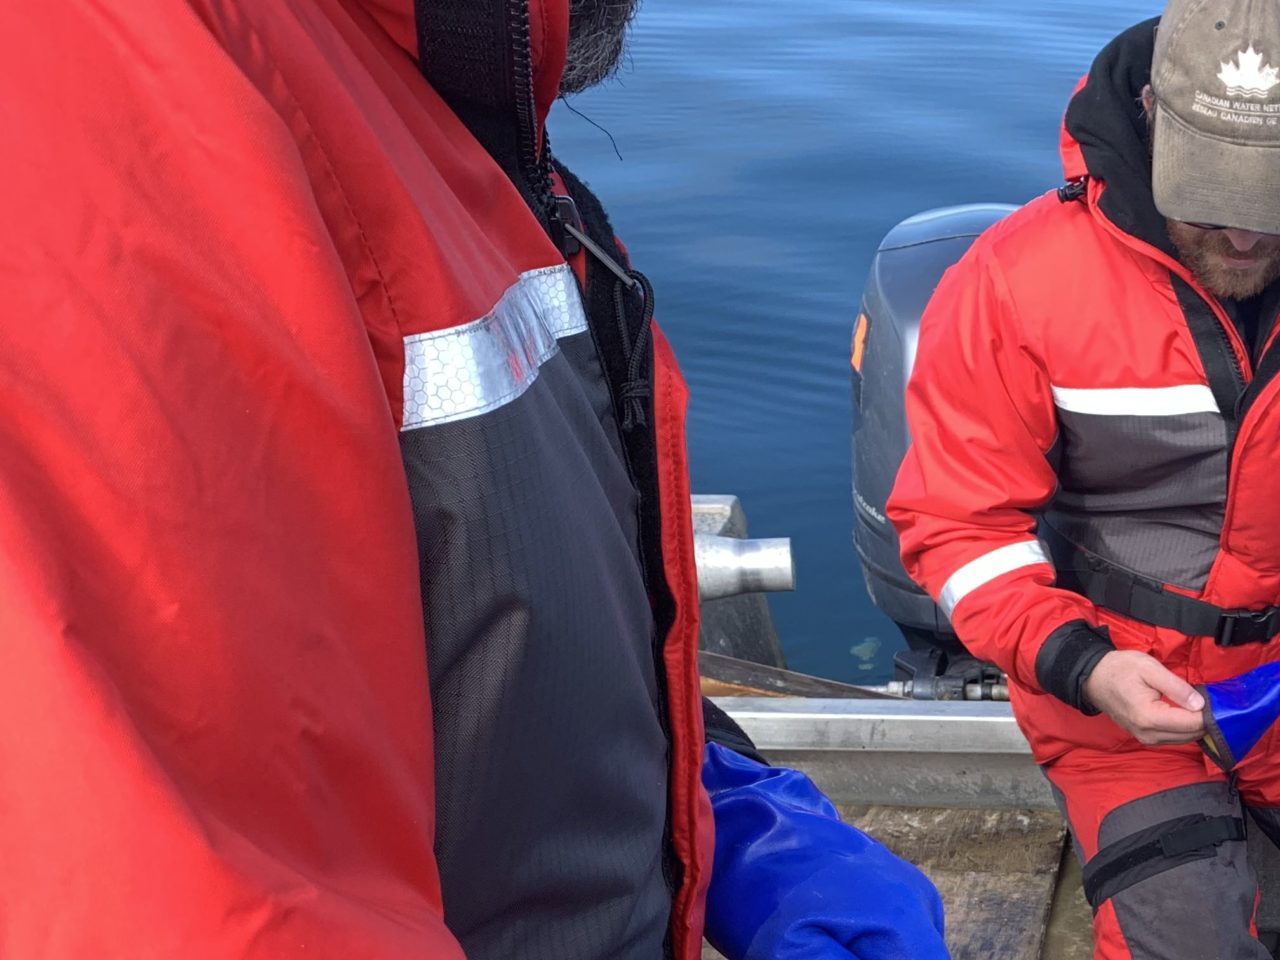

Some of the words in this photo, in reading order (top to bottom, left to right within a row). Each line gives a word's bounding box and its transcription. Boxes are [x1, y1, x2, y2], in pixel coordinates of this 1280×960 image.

[1194, 90, 1230, 109] CANADIAN
[1232, 102, 1261, 111] WATER
[1220, 111, 1263, 125] CANADIEN
[1266, 117, 1278, 125] DE
